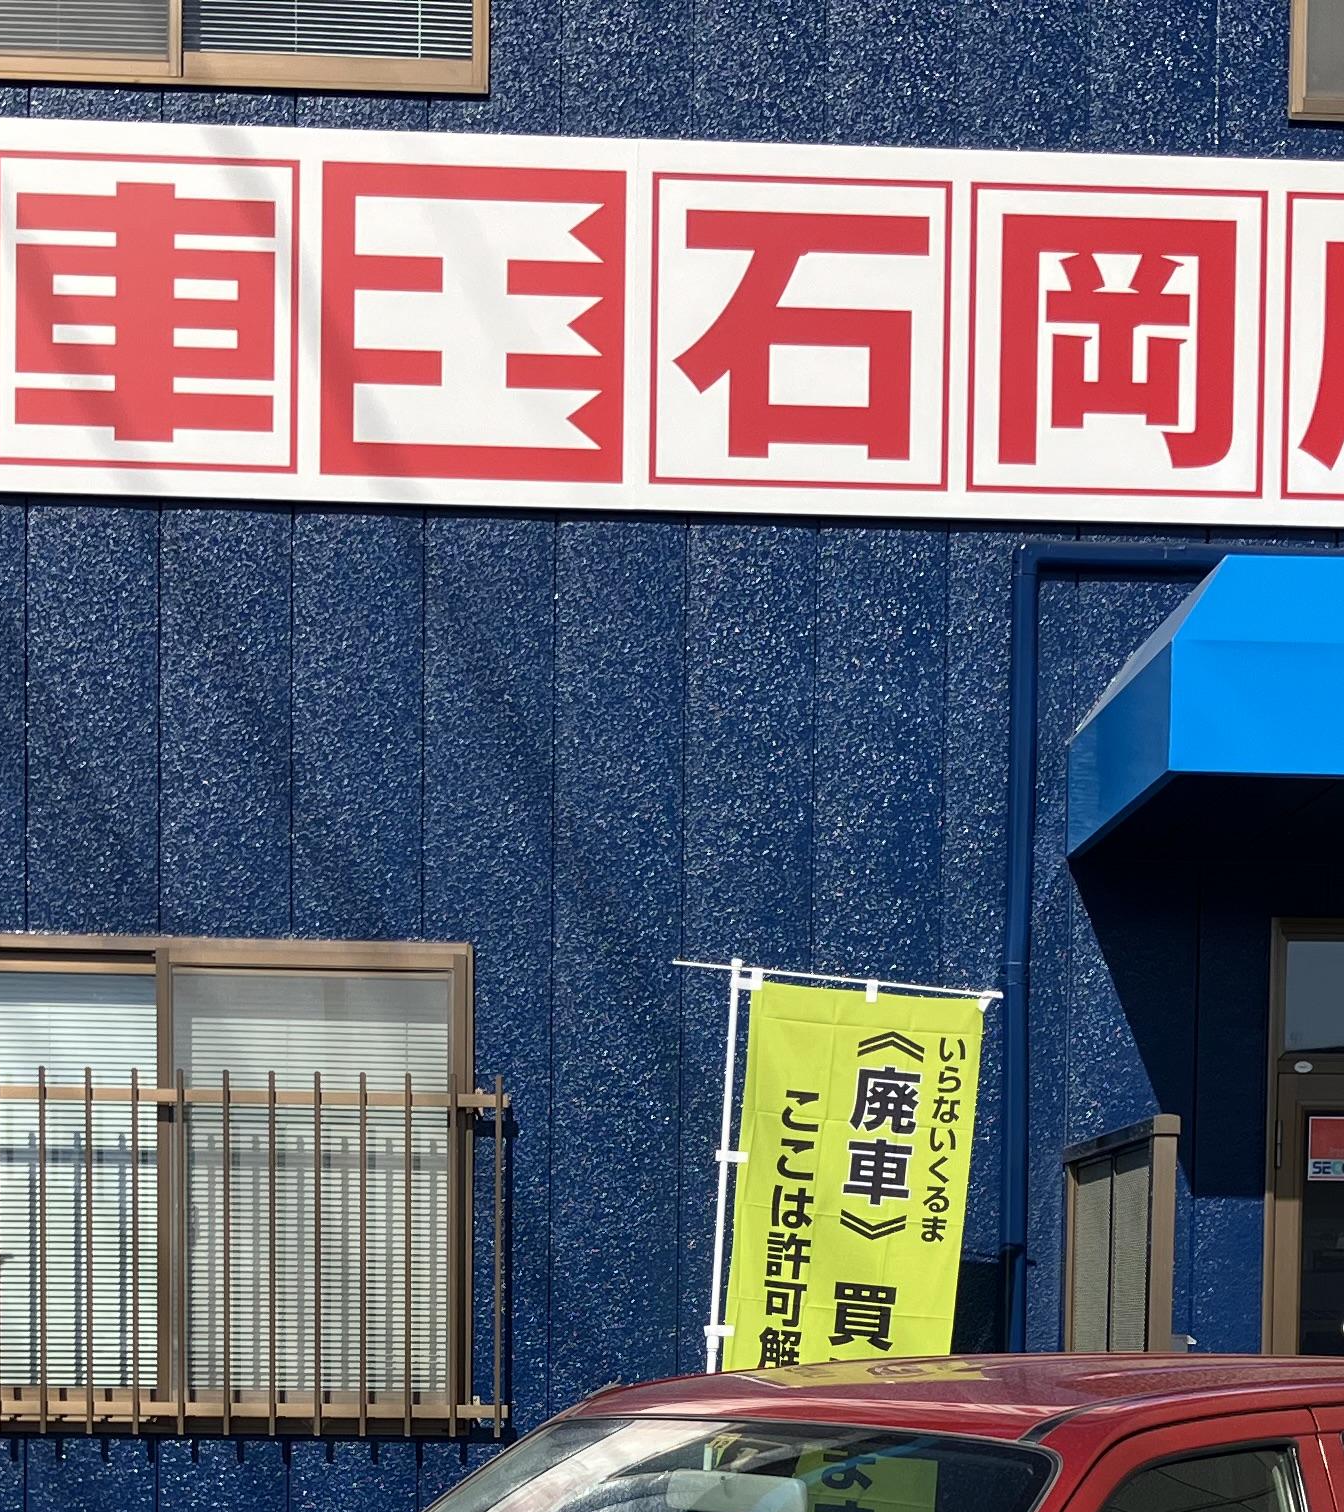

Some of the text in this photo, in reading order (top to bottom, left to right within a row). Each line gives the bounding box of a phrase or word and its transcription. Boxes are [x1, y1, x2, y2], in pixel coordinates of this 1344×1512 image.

[920, 1036, 966, 1243] いらないくるま
[828, 1281, 898, 1362] 買
